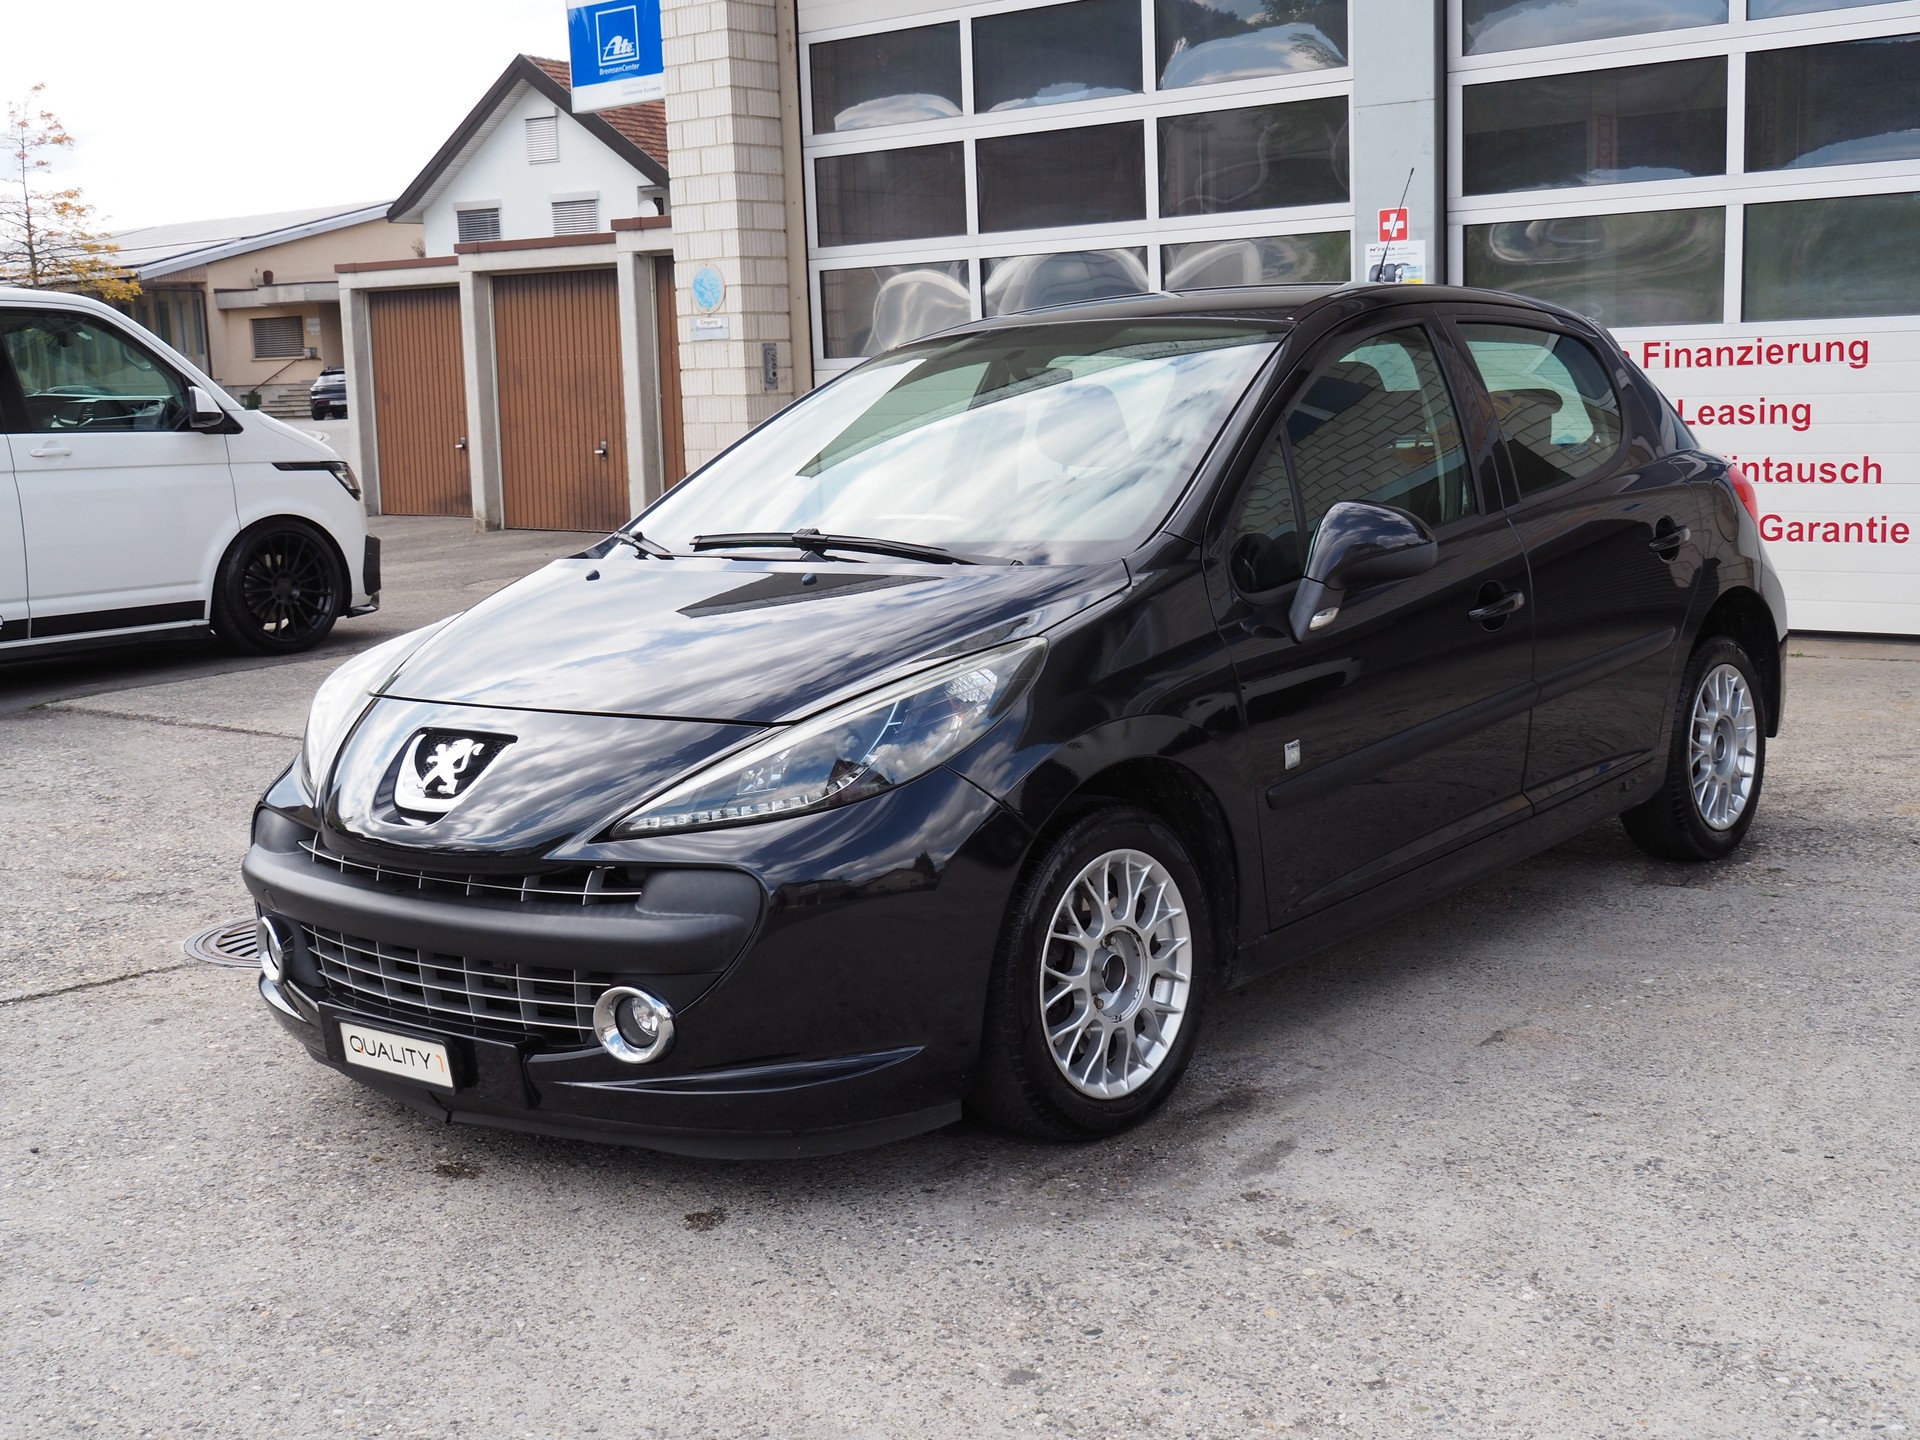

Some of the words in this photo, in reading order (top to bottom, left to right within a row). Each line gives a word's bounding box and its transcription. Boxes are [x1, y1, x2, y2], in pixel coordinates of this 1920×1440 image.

[599, 63, 640, 76] BremsenCenter
[1643, 337, 1869, 369] Finanzierung
[1677, 397, 1811, 432] Leasing
[1723, 455, 1882, 484] ntausch
[1758, 513, 1910, 544] Garantie
